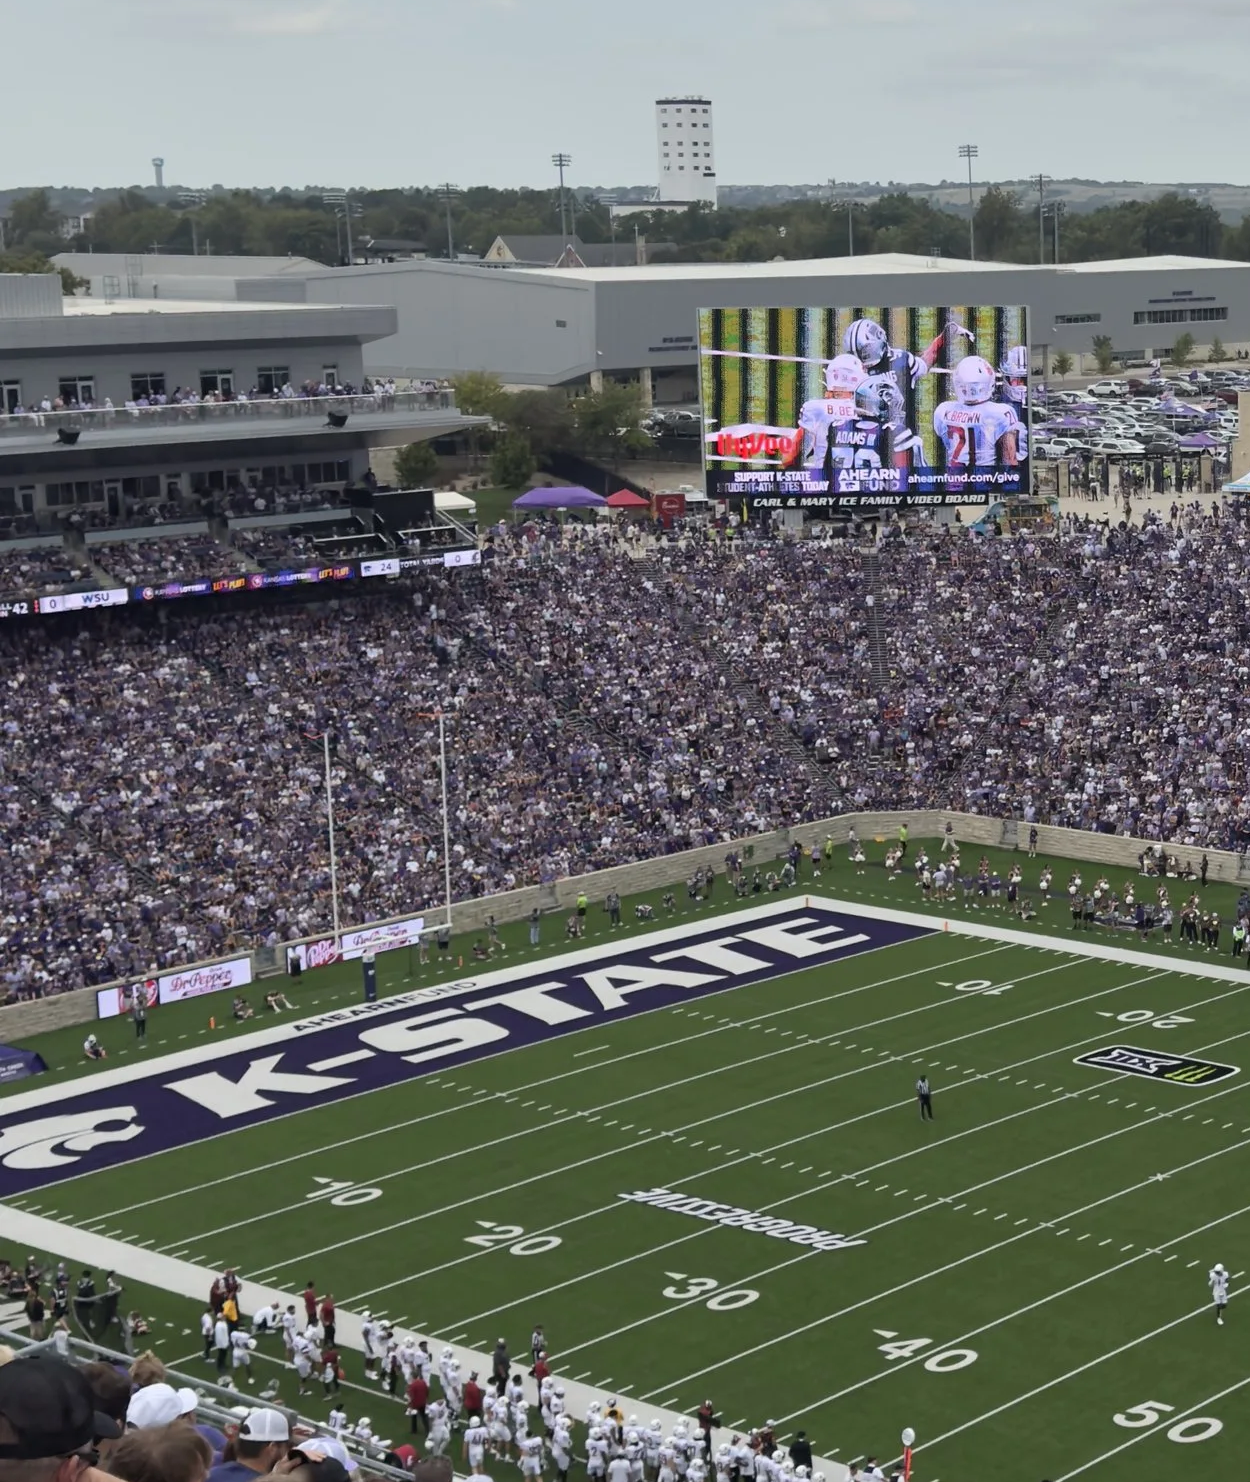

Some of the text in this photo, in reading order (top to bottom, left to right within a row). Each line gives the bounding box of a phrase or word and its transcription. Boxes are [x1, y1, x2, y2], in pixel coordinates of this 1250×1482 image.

[835, 431, 866, 445] ADAMS
[946, 425, 976, 467] 21
[734, 471, 811, 483] SUPPORT K-STATE
[838, 469, 900, 481] AHEARN
[907, 471, 1020, 485] ahearnfund.com/give
[801, 481, 829, 492] TODAY
[861, 481, 900, 493] FUND
[753, 493, 986, 507] CARL & MARY ICE FAMILY VIDEO BOARD
[455, 555, 461, 563] 0
[381, 563, 392, 572] 24
[180, 583, 207, 593] LOTTERY
[212, 580, 228, 591] LET'S
[50, 599, 57, 609] 0
[81, 593, 110, 604] WSU
[12, 602, 28, 615] 42
[953, 978, 1020, 996] 10
[293, 981, 477, 1032] AHEARNFUND
[162, 917, 872, 1119] K-STATE
[1115, 1009, 1196, 1030] 20
[306, 1179, 383, 1206] 10
[617, 1187, 868, 1251] PROGRESSIVE
[463, 1224, 562, 1256] 20
[662, 1276, 760, 1311] 30
[877, 1336, 979, 1373] 40
[1113, 1399, 1224, 1444] 50
